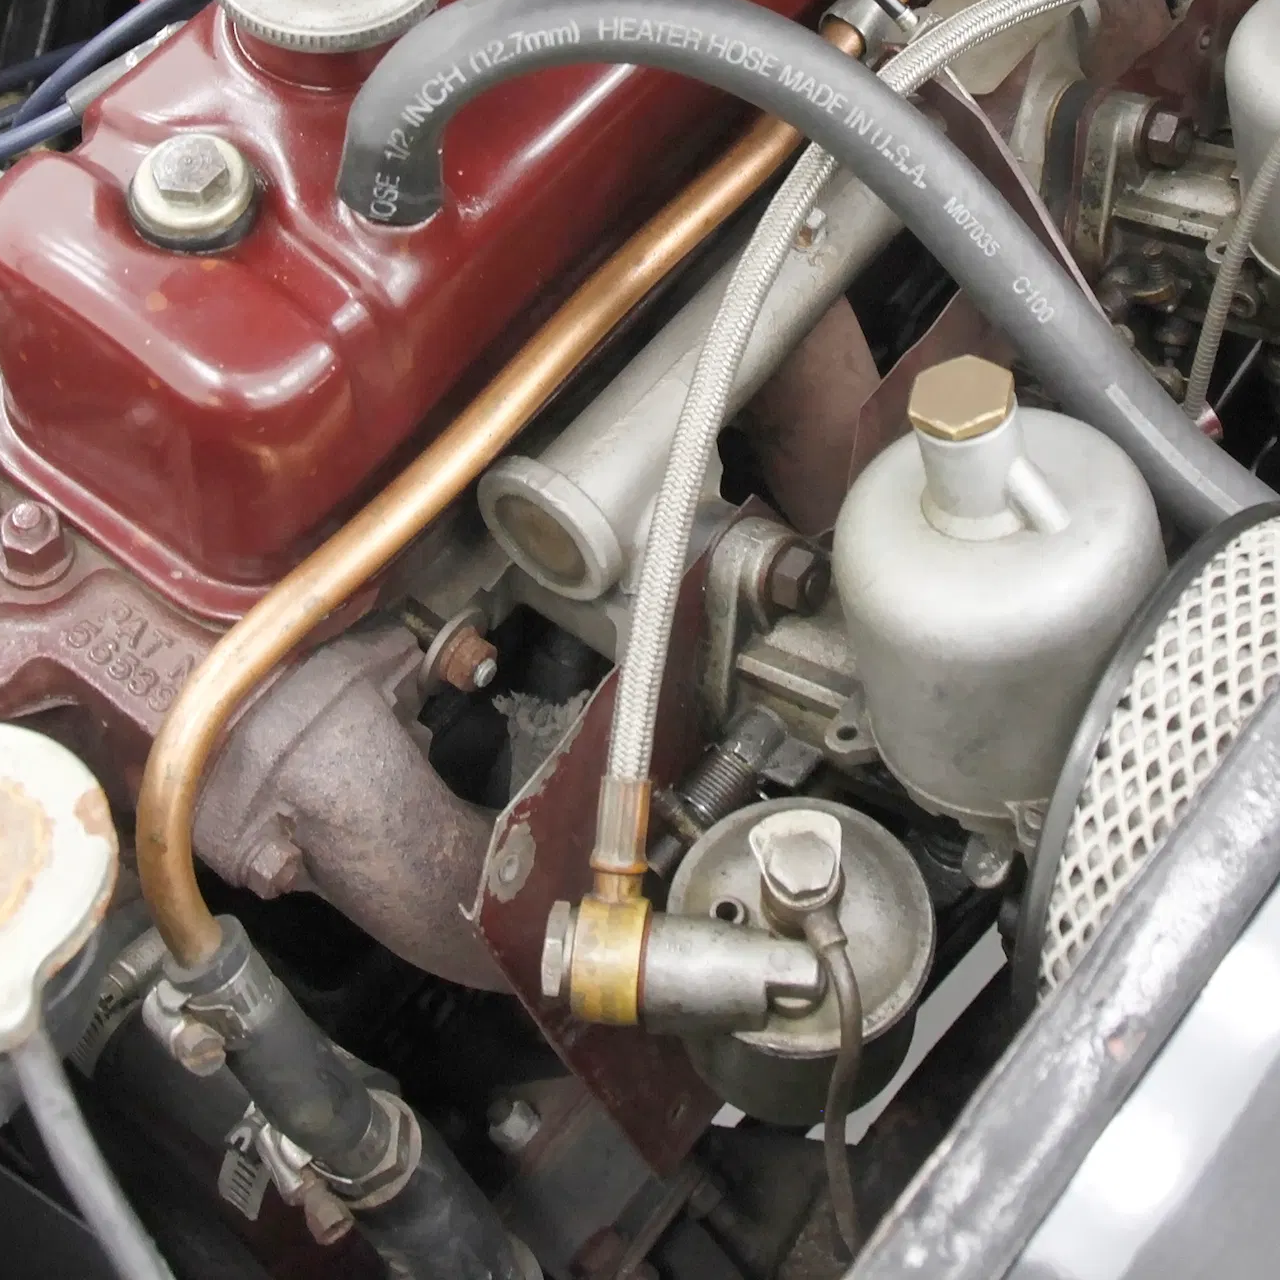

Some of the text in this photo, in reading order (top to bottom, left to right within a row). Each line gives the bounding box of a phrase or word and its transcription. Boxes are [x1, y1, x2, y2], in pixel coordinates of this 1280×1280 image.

[469, 19, 581, 74] (12.7mm)
[597, 17, 705, 51] HEATER
[706, 33, 780, 78] HOSE
[401, 63, 467, 128] INCH
[777, 63, 849, 115] MADE
[384, 129, 415, 162] 1/2
[843, 105, 874, 136] IN
[870, 125, 928, 190] U.S.A.
[368, 172, 401, 222] OSE
[942, 195, 1001, 258] M07035
[103, 598, 175, 658] PAT
